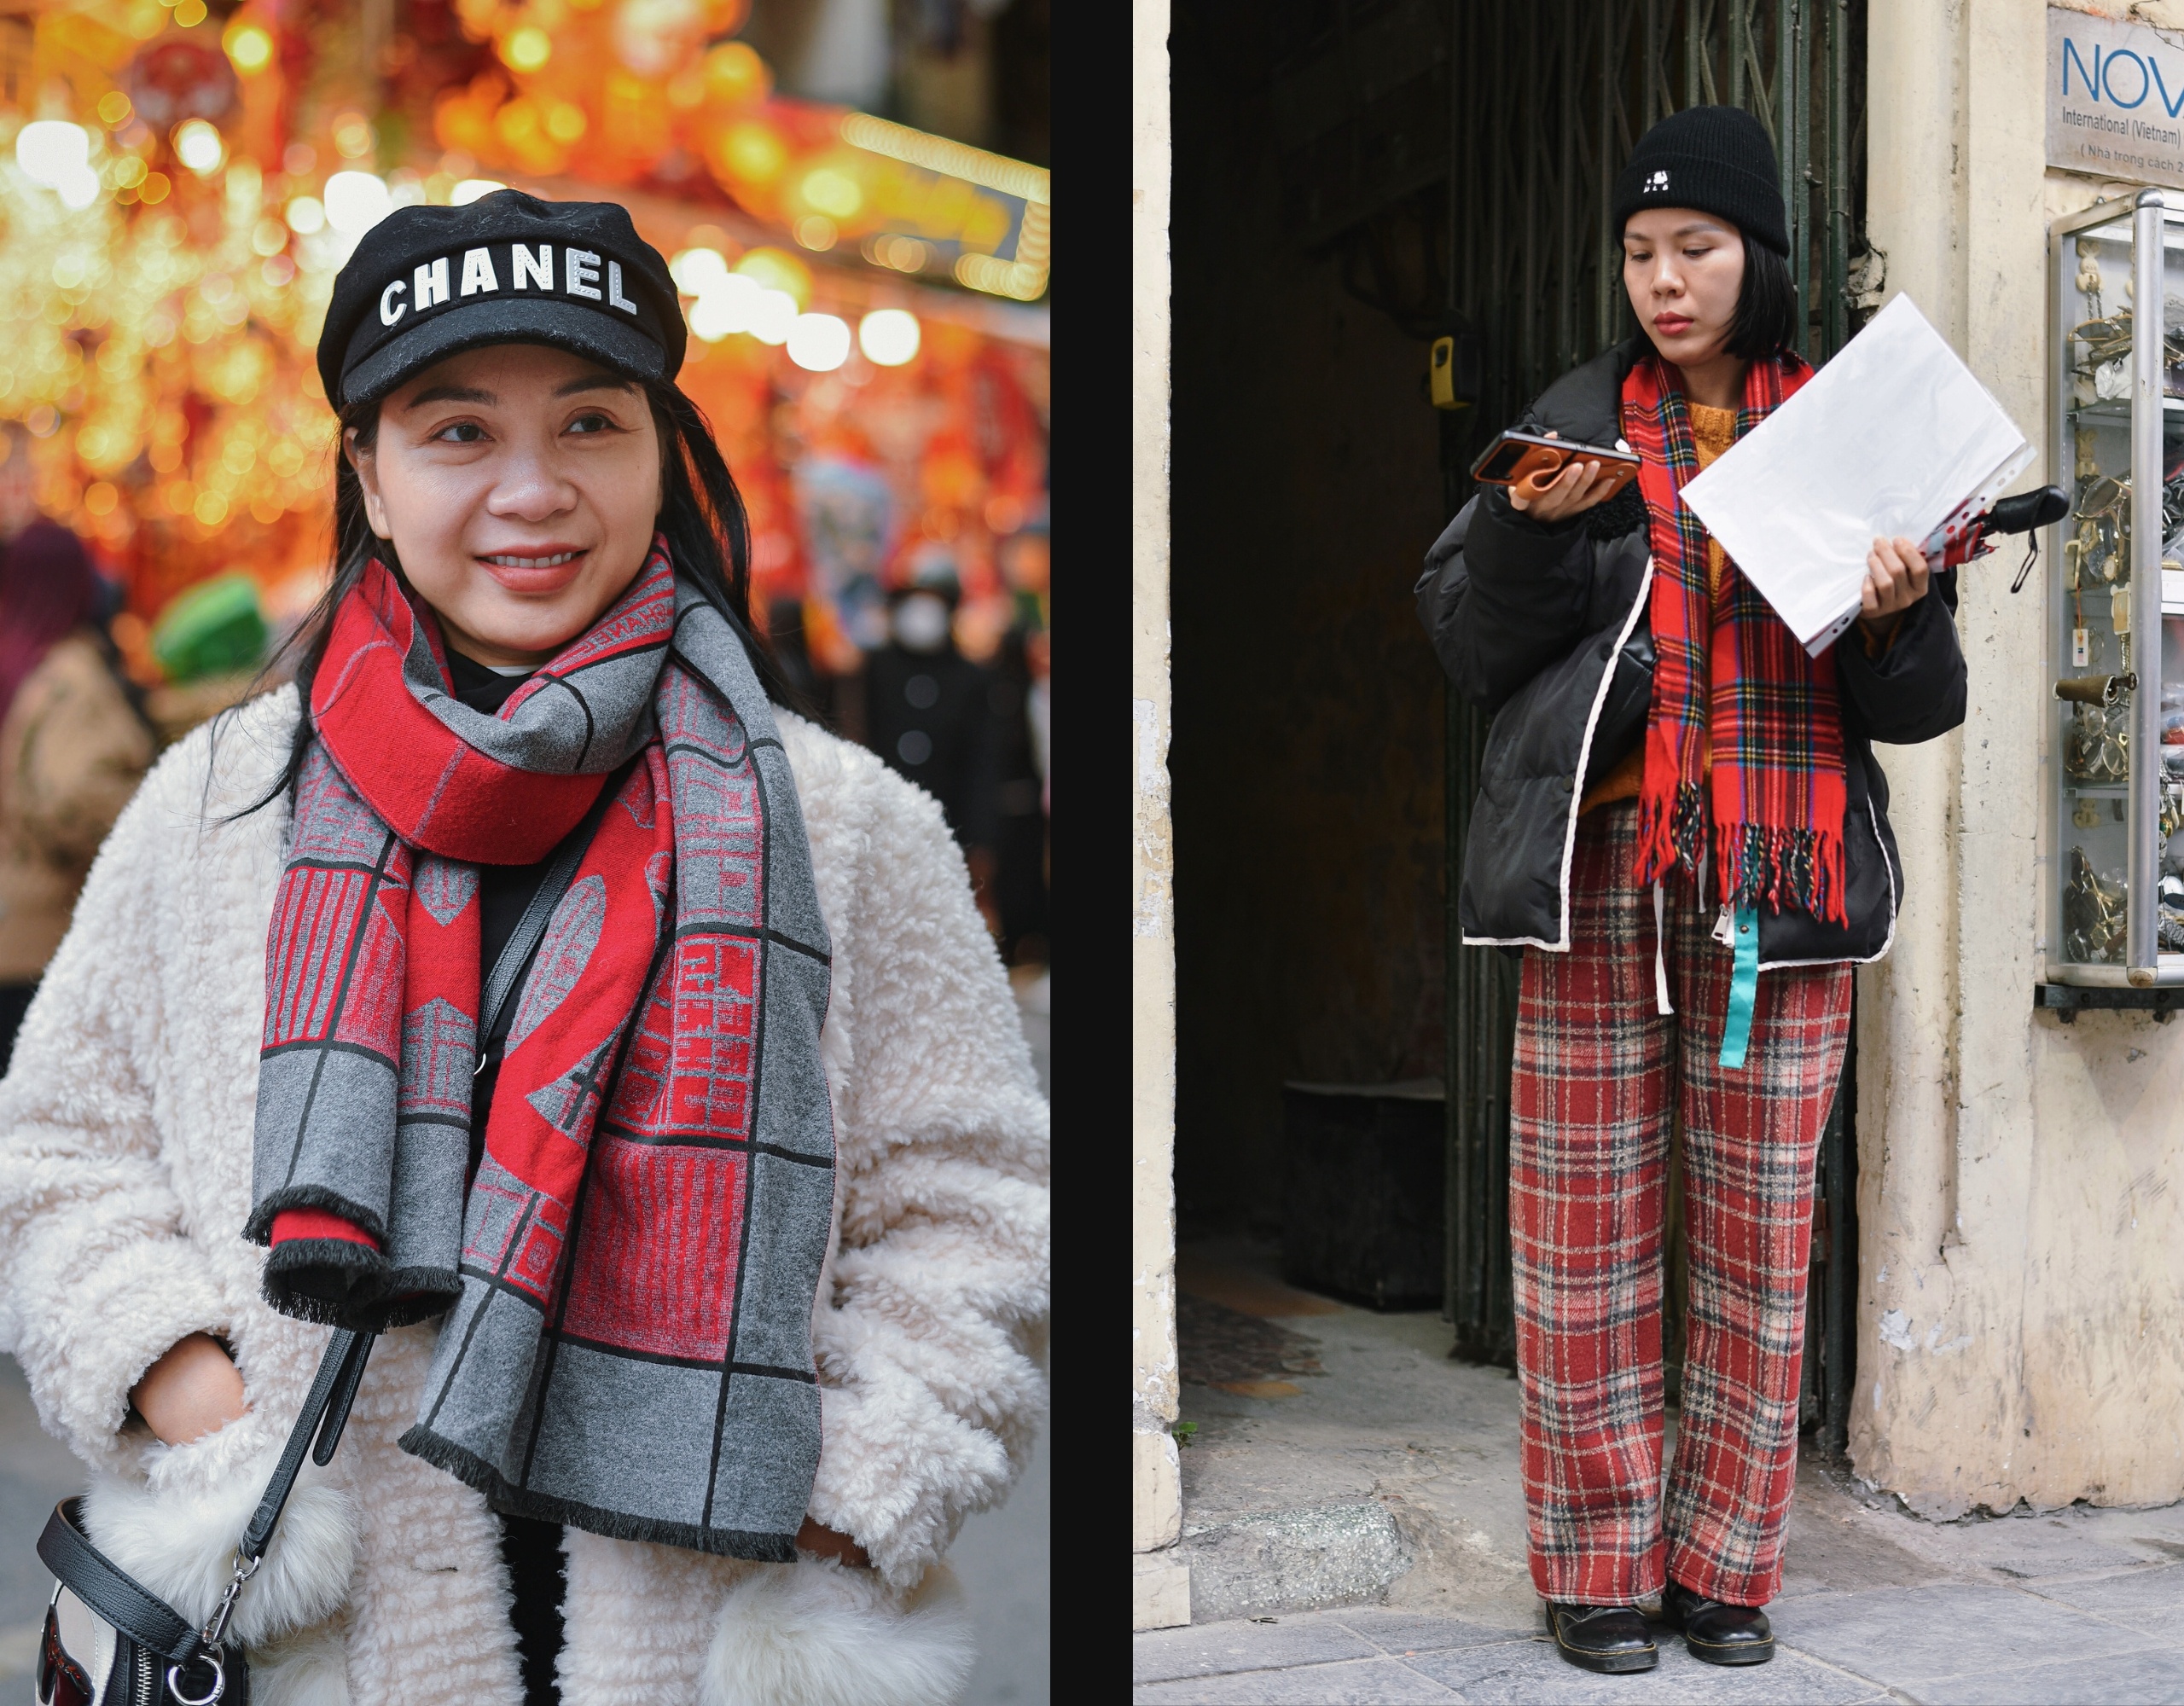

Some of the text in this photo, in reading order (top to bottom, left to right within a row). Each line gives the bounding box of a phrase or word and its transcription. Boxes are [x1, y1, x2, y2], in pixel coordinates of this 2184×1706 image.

[2062, 38, 2184, 118] NOV
[2062, 106, 2181, 150] International (Vietnam)
[2114, 150, 2144, 168] trong
[380, 243, 638, 328] CHANEL
